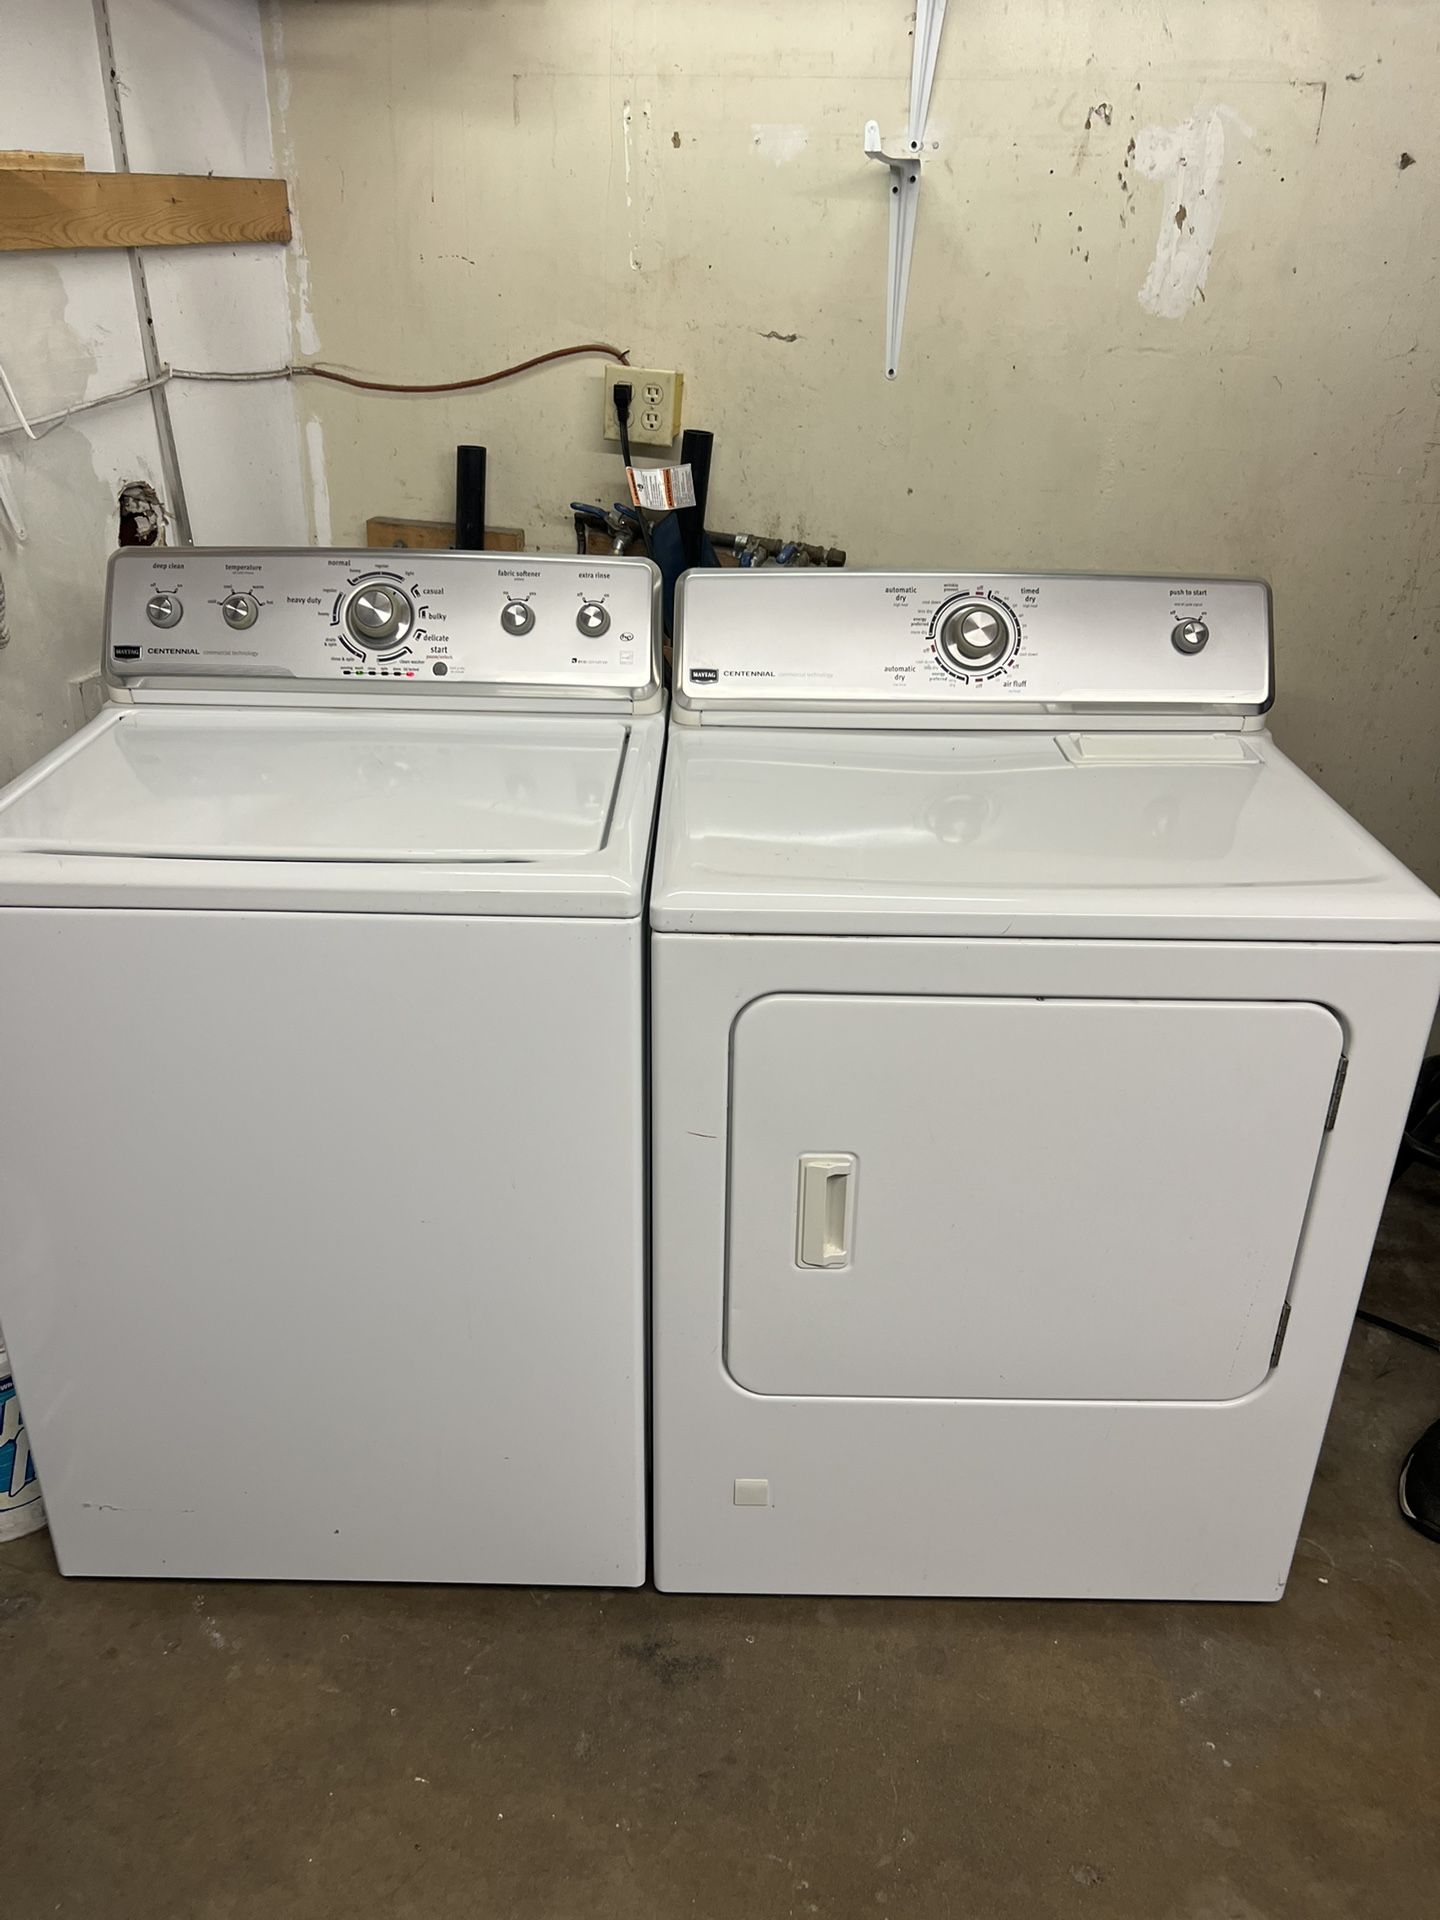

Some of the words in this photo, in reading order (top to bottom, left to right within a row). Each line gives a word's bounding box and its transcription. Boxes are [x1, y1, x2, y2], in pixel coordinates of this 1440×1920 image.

[152, 563, 167, 571] deep
[225, 564, 262, 572] temperature
[498, 569, 515, 577] fabric
[423, 587, 445, 595] casual
[885, 586, 917, 594] automatic
[1169, 589, 1185, 597] push
[287, 596, 305, 604] heavy
[306, 596, 322, 605] duty
[895, 594, 907, 603] dry
[1024, 595, 1036, 603] dry
[428, 613, 447, 622] bulky
[423, 634, 449, 642] delicate
[147, 647, 200, 655] CENTENNIAL
[430, 646, 448, 654] start
[883, 665, 916, 673] automatic
[692, 671, 716, 679] MAYTAG
[723, 670, 776, 678] CENTENNIAL
[894, 674, 906, 682] dry
[1003, 680, 1012, 688] air
[1012, 680, 1027, 688] fluff
